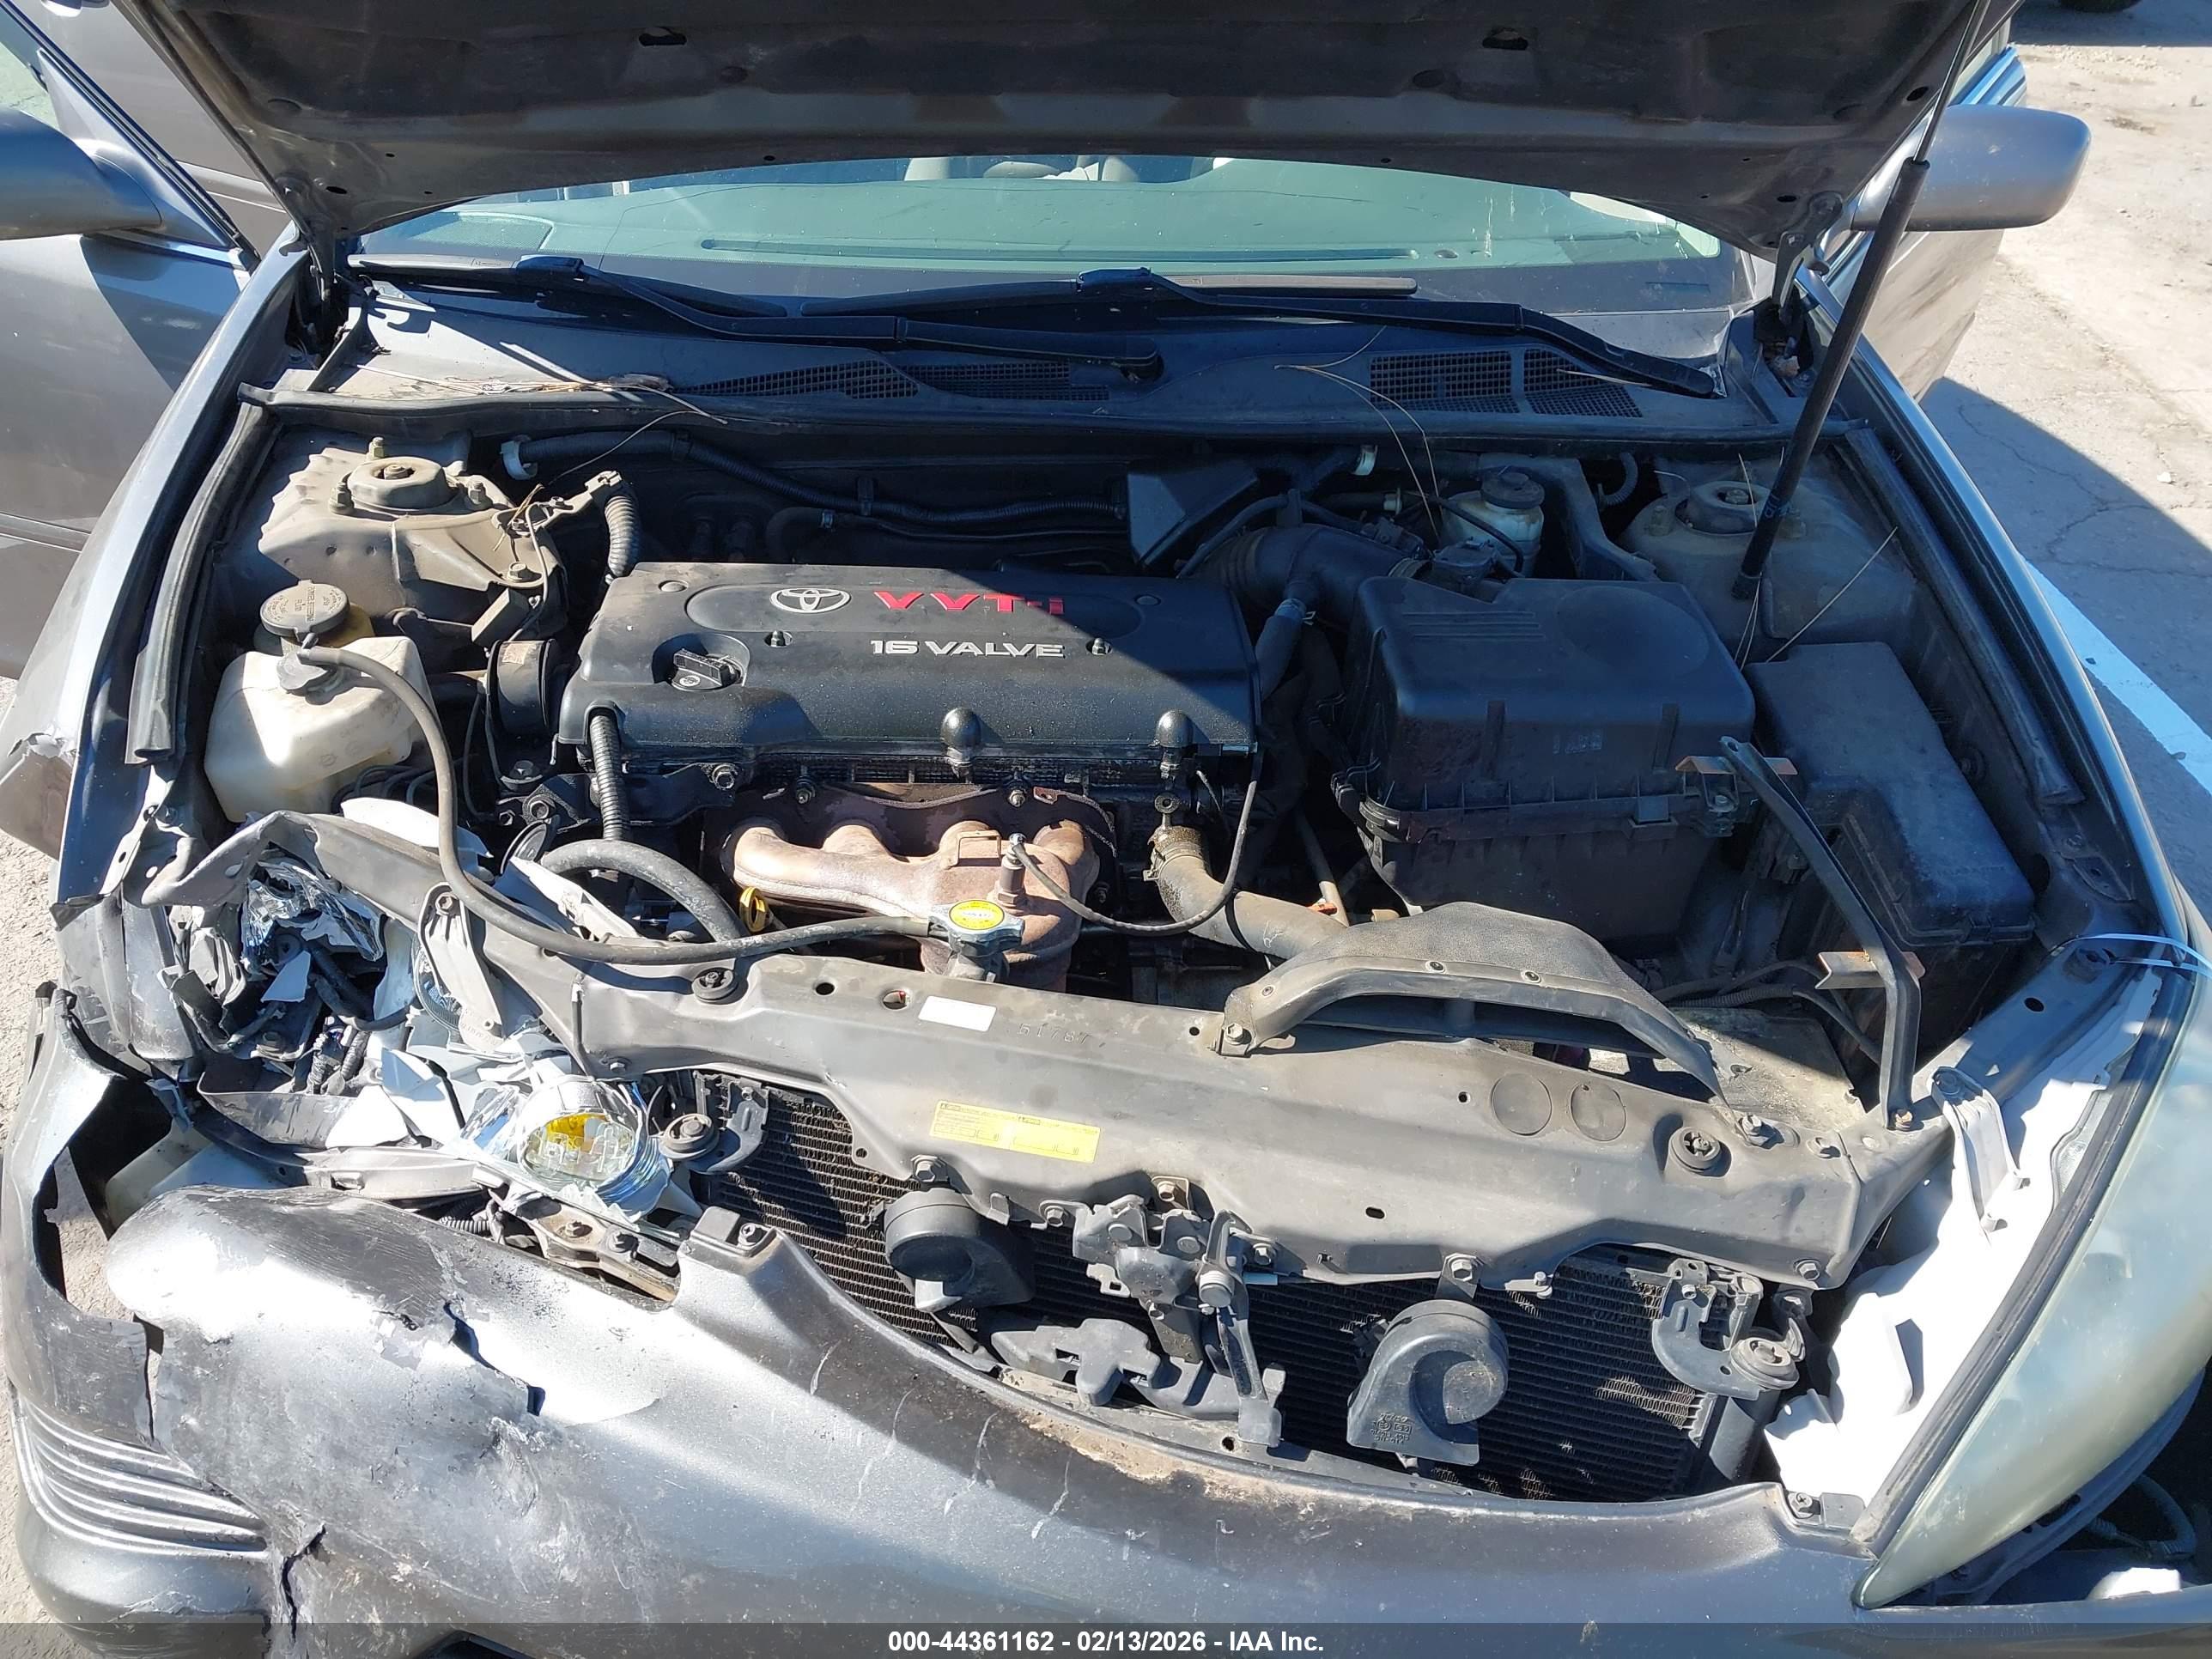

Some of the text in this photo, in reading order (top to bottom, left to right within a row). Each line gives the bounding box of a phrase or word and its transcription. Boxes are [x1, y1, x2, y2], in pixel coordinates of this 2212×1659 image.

[874, 591, 1064, 615] VVT-i
[871, 641, 1065, 658] 16 VALVE
